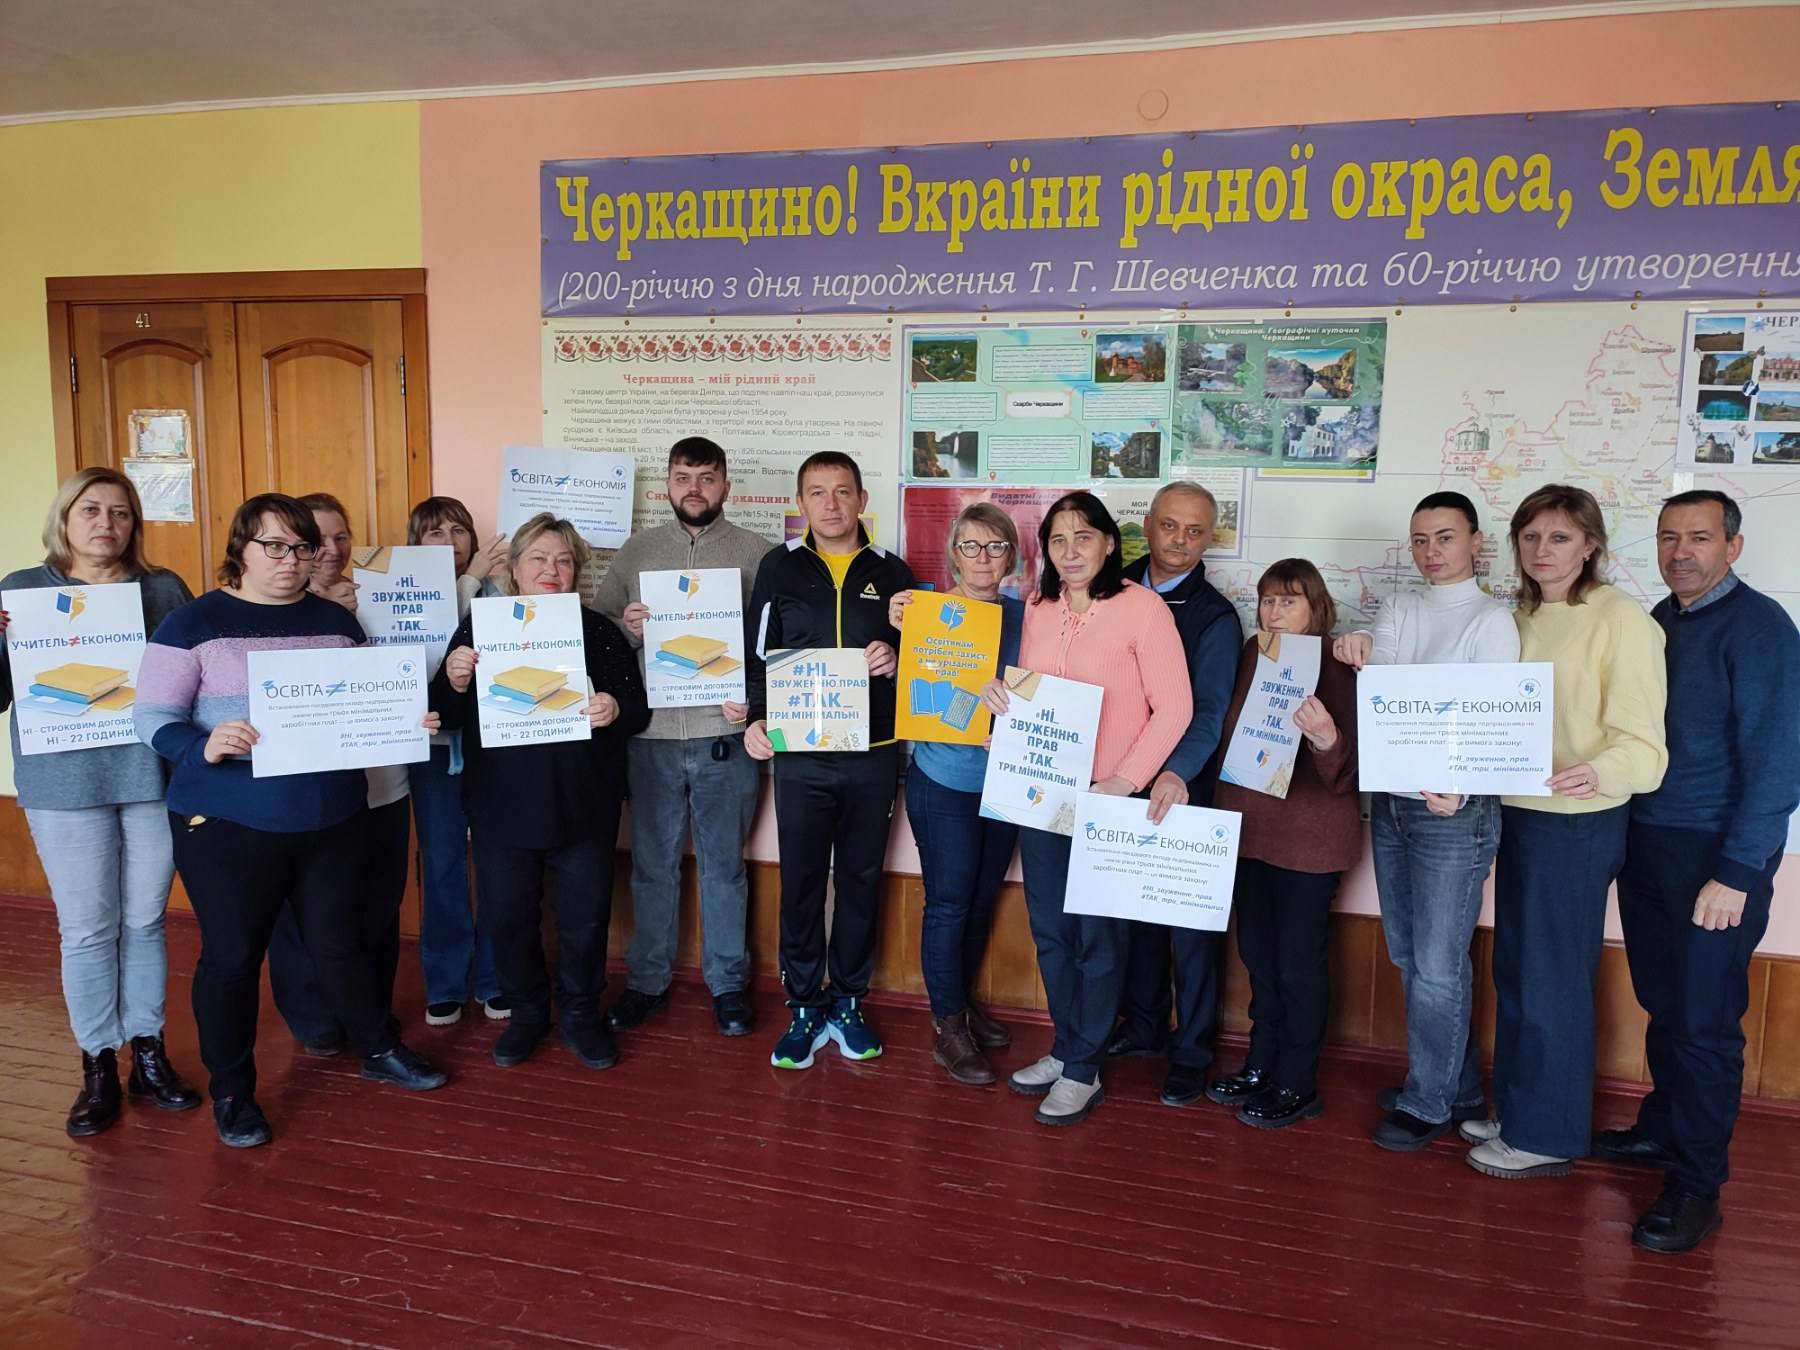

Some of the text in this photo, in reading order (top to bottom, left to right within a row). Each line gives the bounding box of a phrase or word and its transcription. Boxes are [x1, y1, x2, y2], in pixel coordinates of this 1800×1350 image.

[556, 165, 858, 261] Черкащино!
[878, 157, 1101, 253] Вкраїни
[1120, 143, 1314, 249] рідної
[1331, 152, 1573, 240] окраса,
[558, 249, 1800, 309] (200-річчю з дня народження Т. Г. Шевченка та 60-річчю утворенн
[135, 312, 151, 328] 41
[623, 372, 816, 387] Черкащина мій рідний край
[512, 473, 553, 486] ОСВІТА
[573, 478, 626, 491] ЕКОНОМІЯ
[990, 492, 1036, 500] Видатні
[392, 603, 423, 615] ПРАВ
[926, 636, 974, 649] Освітянам
[913, 646, 954, 658] потрібен
[265, 679, 418, 699] ОСВІТА ЕКОНОМІЯ
[694, 692, 731, 701] ГОДИНИ!
[1268, 697, 1288, 711] ПРАВ
[1373, 700, 1541, 714] ОСВІТА ЕКОНОМІЯ
[23, 717, 134, 736] НІ СТРОКОВИМ ДОГОВО
[496, 719, 541, 729] СТРОКОВИМ
[47, 736, 59, 745] НІ
[70, 733, 84, 744] 22
[501, 726, 574, 740] НІ 22 ГОДИНИ!
[1027, 736, 1058, 752] ПРАВ
[1387, 738, 1428, 746] заробітних
[1086, 828, 1229, 857] ОСВІТА ЕКОНОМІЯ
